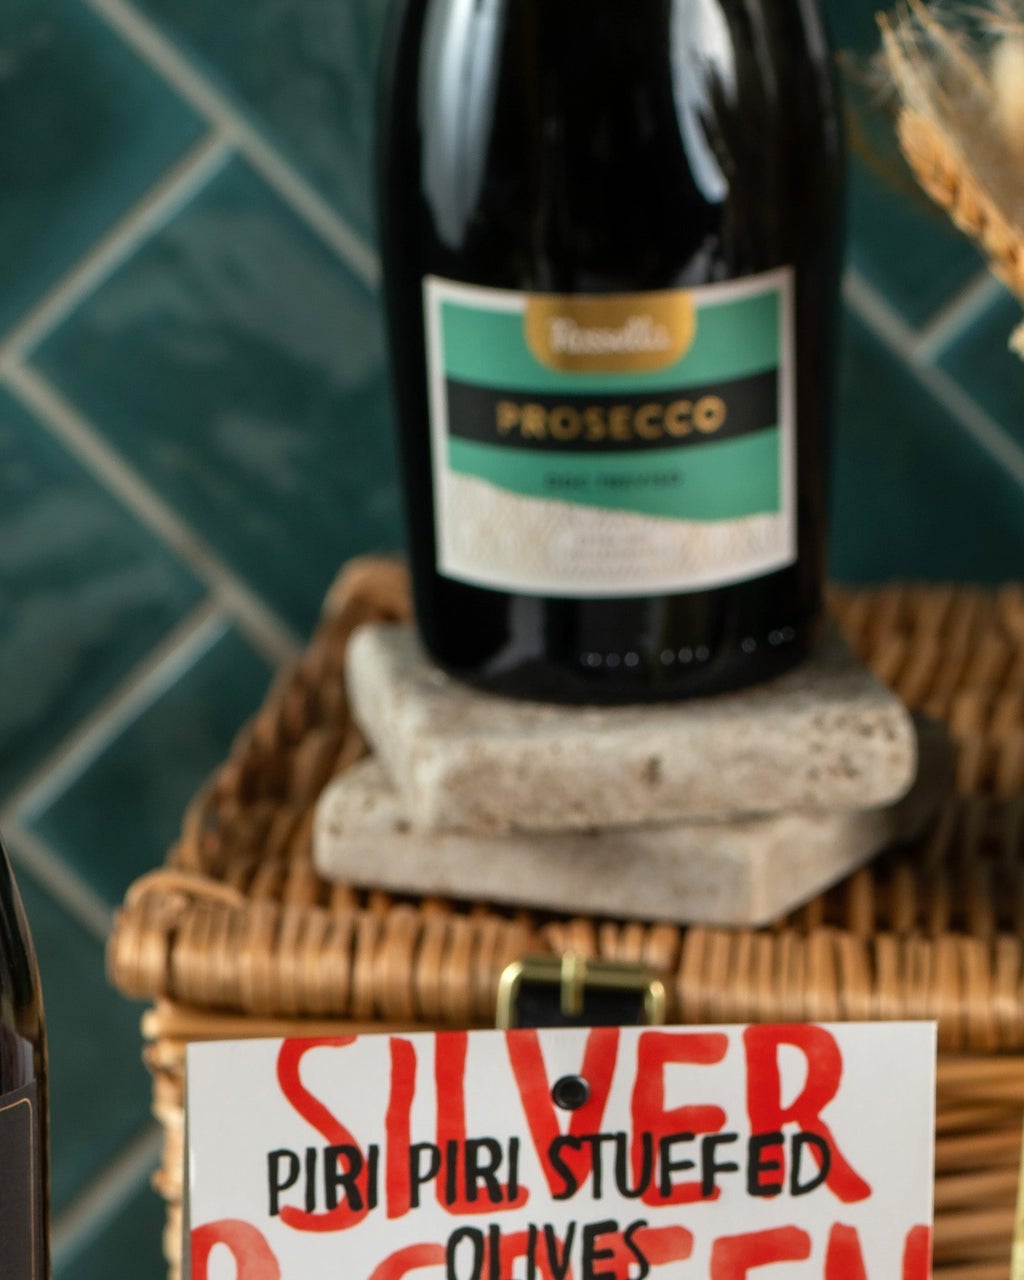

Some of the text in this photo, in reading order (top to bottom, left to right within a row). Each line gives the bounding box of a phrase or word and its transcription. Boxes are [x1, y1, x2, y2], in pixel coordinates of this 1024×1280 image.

[495, 395, 728, 442] PROSECCO
[276, 1023, 873, 1234] SILVER
[267, 1131, 831, 1217] PIRI PIRI STUFFED
